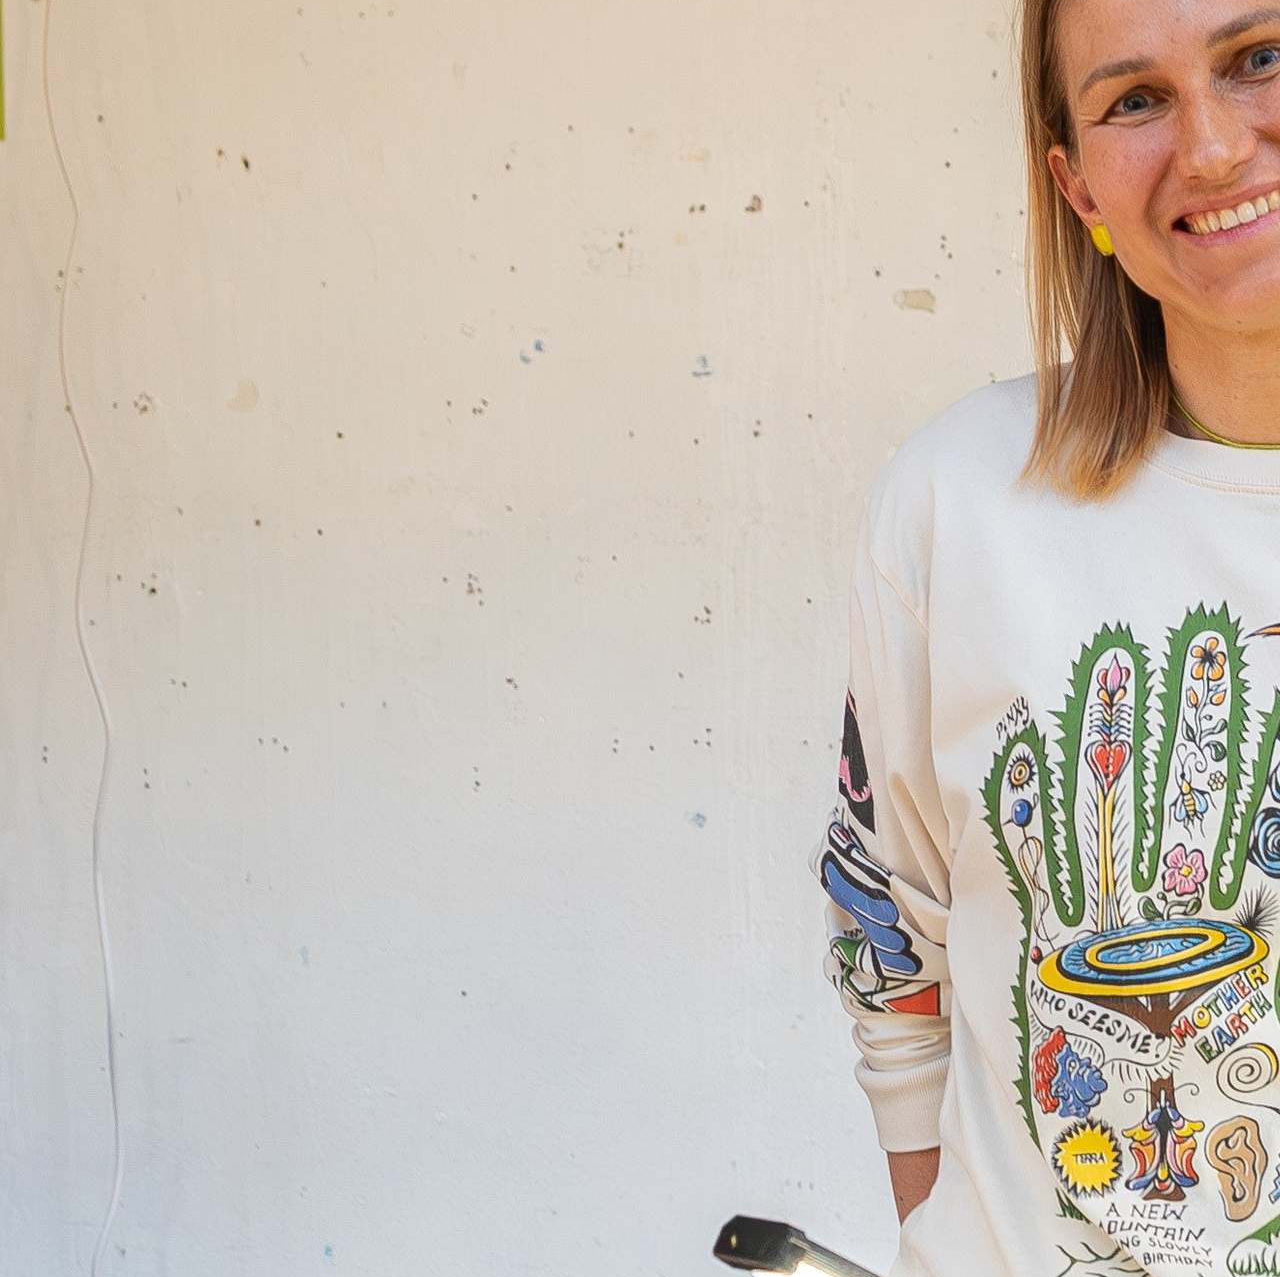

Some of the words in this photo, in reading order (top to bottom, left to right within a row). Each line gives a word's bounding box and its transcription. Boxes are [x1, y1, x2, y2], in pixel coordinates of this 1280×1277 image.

[1170, 963, 1269, 1048] MOTHER
[1030, 980, 1067, 1015] WHO
[1067, 1002, 1122, 1036] SEES
[1115, 1024, 1167, 1059] ME?
[1194, 989, 1273, 1064] EARTH
[1072, 1152, 1106, 1164] TERRA
[1106, 1202, 1121, 1218] A
[1131, 1203, 1188, 1222] NEW
[1099, 1220, 1206, 1242] OUNTAIN
[1148, 1237, 1213, 1257] SLOWLY
[1143, 1251, 1213, 1268] BIRTHDAY
